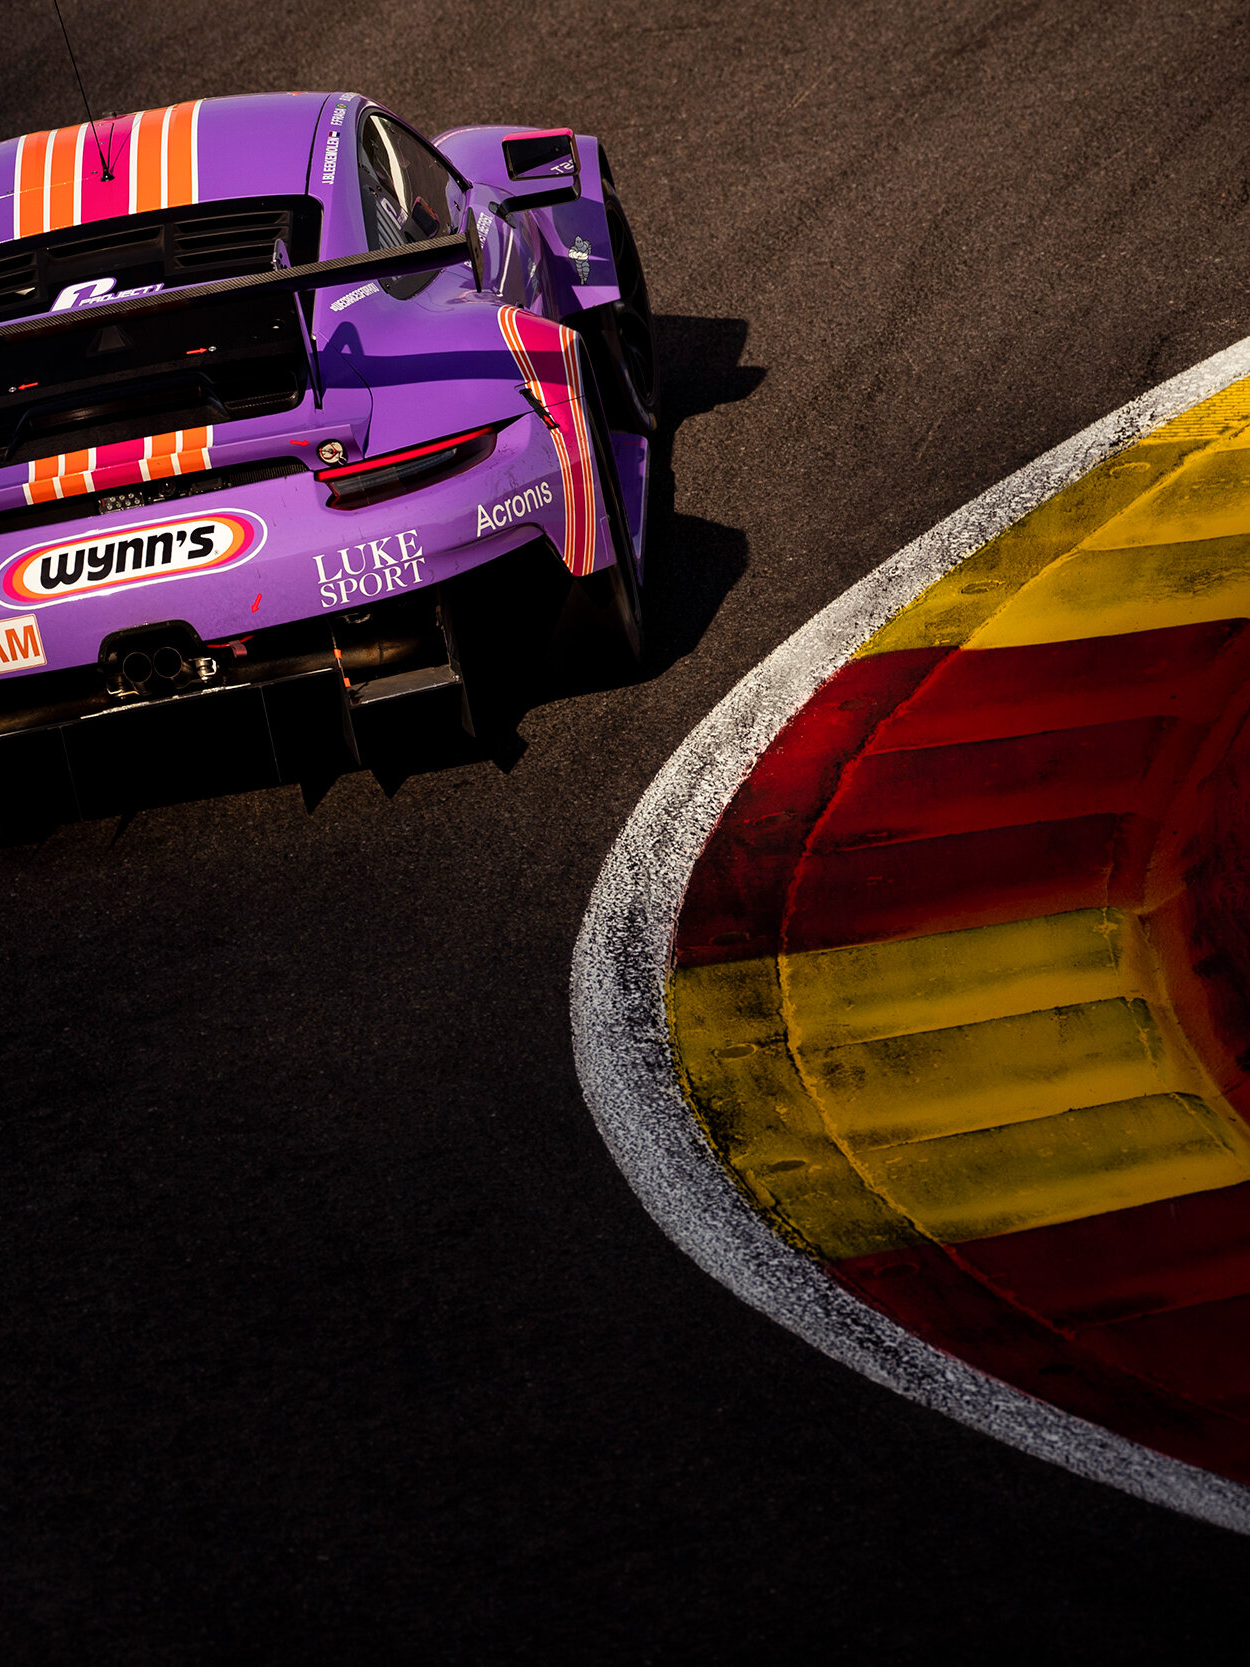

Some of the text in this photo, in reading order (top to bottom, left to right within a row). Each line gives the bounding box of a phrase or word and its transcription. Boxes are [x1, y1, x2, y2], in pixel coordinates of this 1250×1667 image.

[78, 285, 153, 307] PROJECT
[476, 481, 553, 538] Acronis
[40, 525, 215, 590] wynn's
[313, 529, 423, 584] LUKE
[320, 557, 426, 608] SPORT
